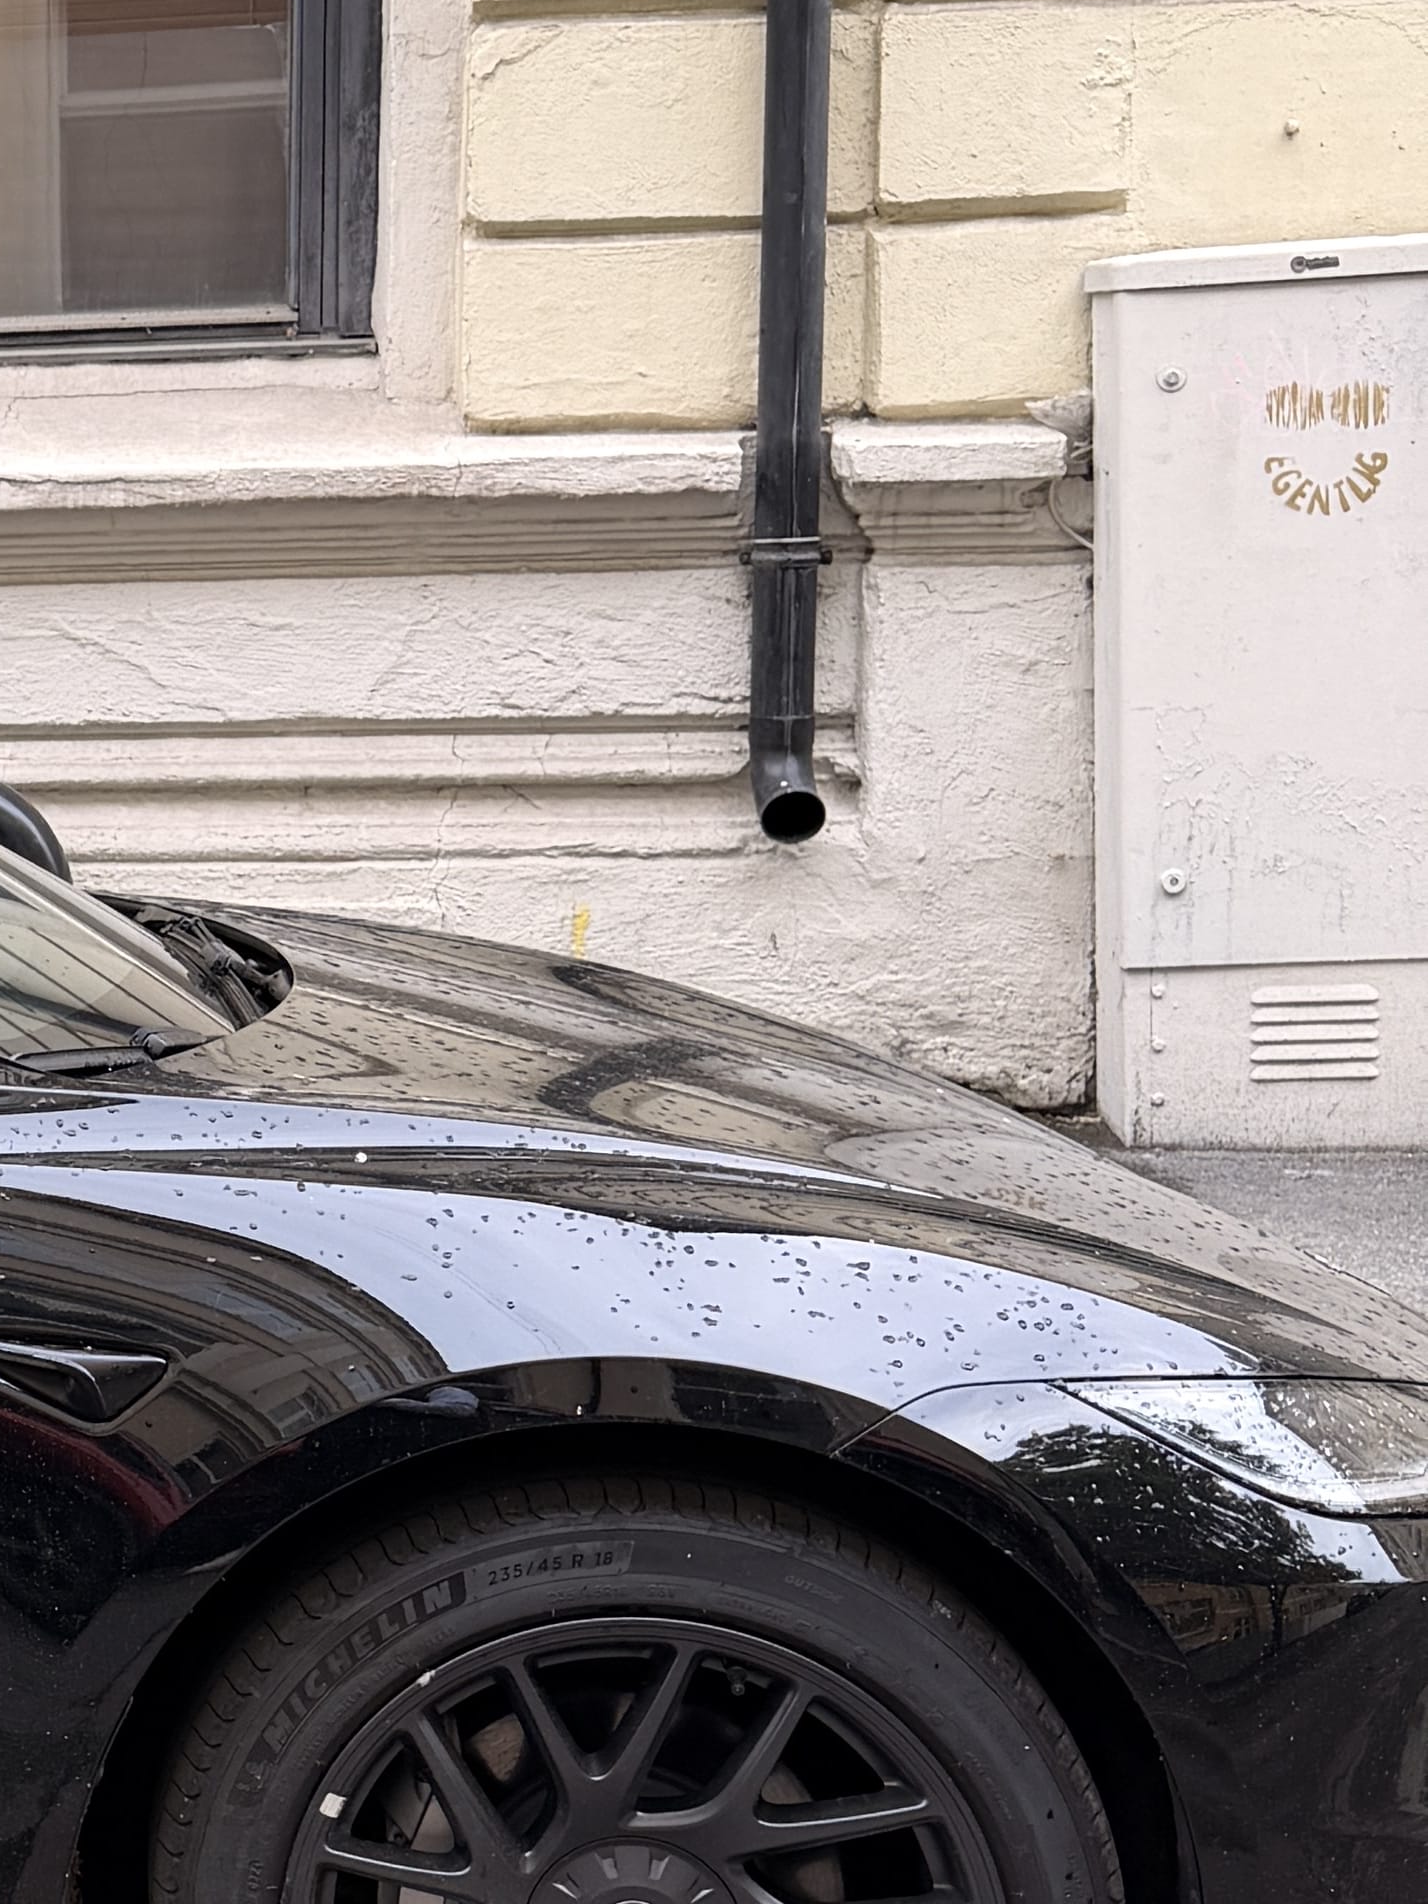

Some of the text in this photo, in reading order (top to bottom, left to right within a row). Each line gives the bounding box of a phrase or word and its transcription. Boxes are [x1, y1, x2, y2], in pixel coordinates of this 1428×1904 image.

[1263, 451, 1388, 516] EGENTLIG
[488, 1551, 614, 1586] 235/45 R 18
[262, 1579, 453, 1753] MICHELIN
